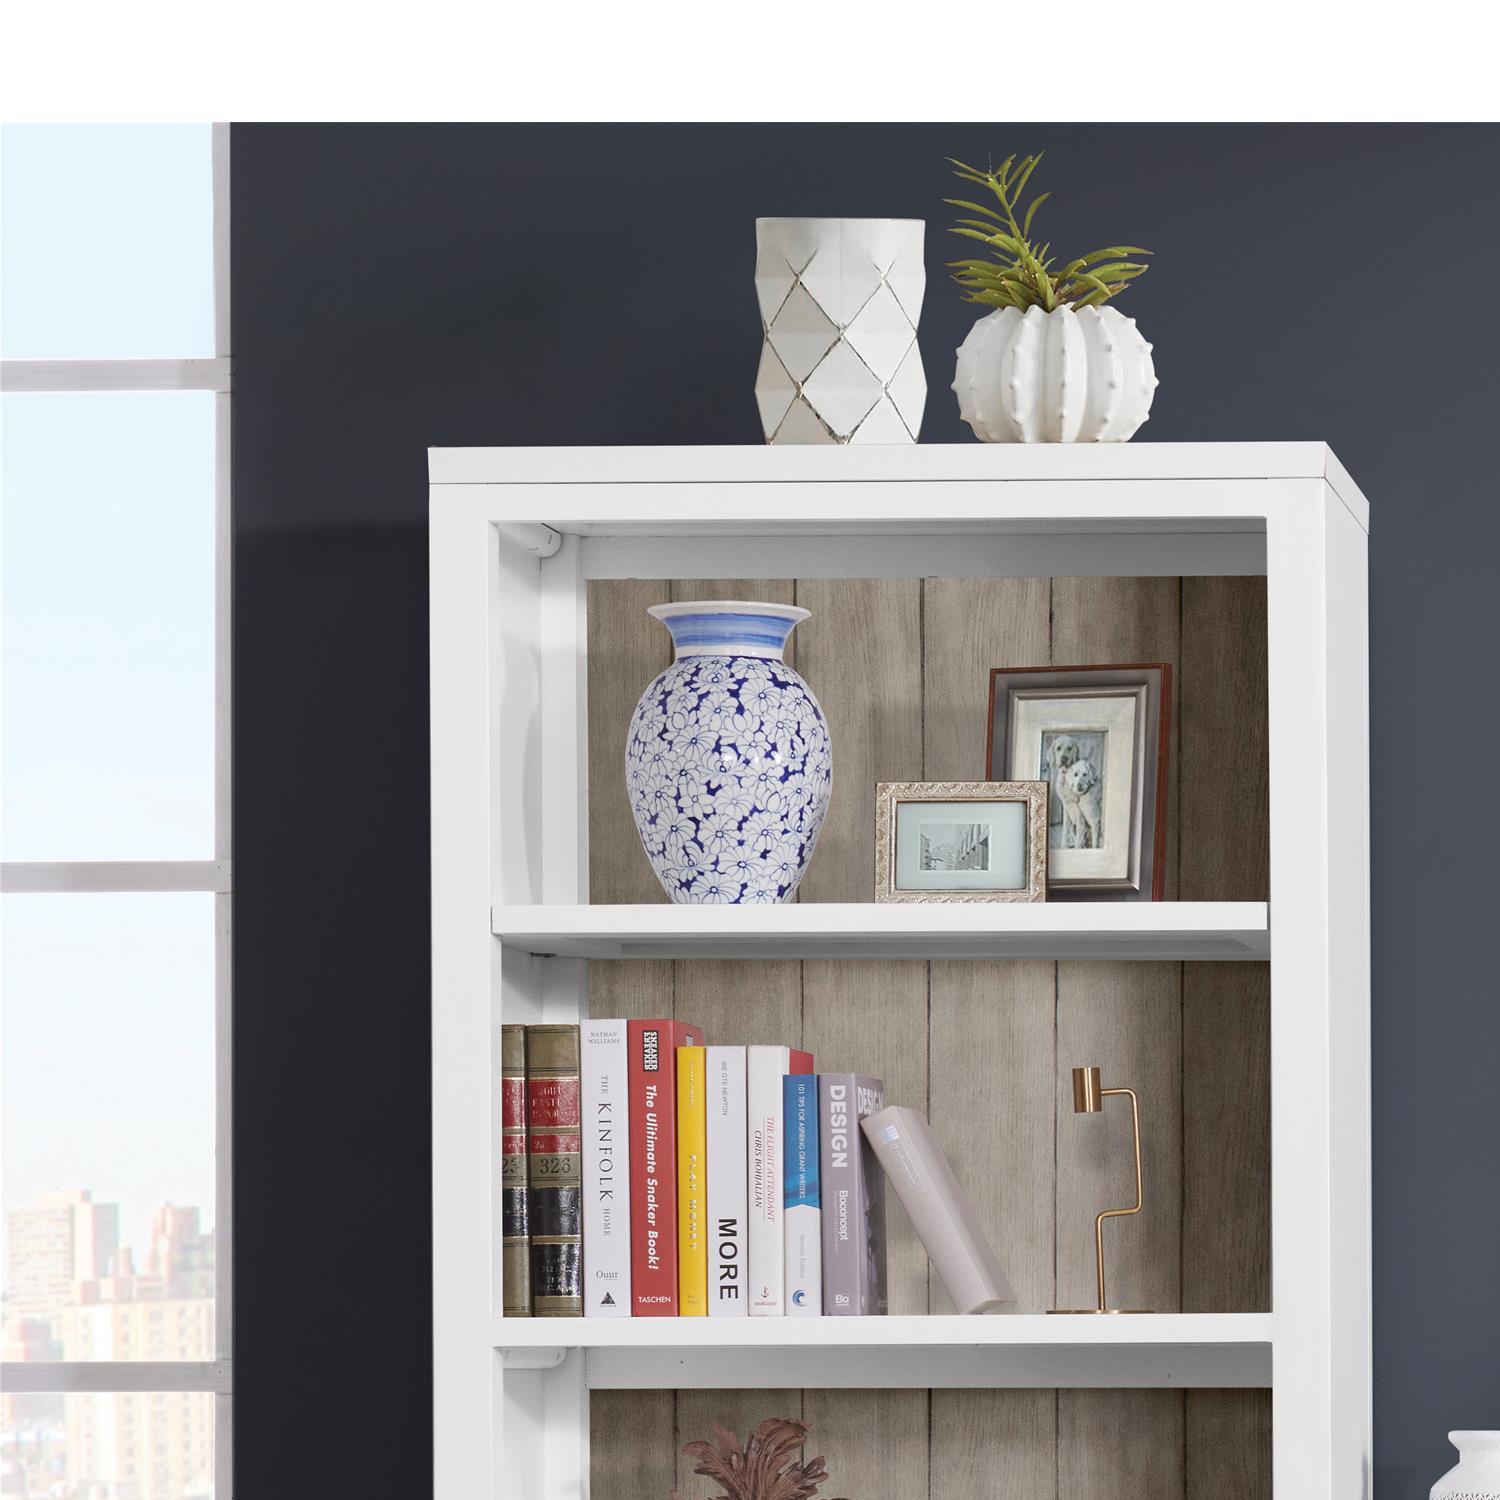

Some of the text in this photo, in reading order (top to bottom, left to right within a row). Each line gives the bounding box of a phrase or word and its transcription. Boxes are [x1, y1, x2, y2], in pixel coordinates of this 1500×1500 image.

[798, 1096, 806, 1108] TIPS
[857, 1086, 883, 1115] DESIGN
[799, 1122, 807, 1149] ASPIRING
[830, 1085, 848, 1168] DESIGN
[598, 1074, 614, 1237] THE KINFOLK HOME
[754, 1130, 763, 1156] CHRIS
[540, 1158, 571, 1174] 326
[767, 1116, 776, 1223] THE FLIGHT ATTENDANT
[799, 1150, 807, 1172] GRANT
[646, 1084, 661, 1270] The Ulitimate Snaker Book!
[799, 1173, 807, 1198] WRITERS
[689, 1154, 697, 1250] PLAY MONEY
[838, 1190, 849, 1241] Boconcept
[718, 1218, 739, 1300] MORE
[595, 1270, 619, 1279] Ouur
[836, 1294, 850, 1304] Bo
